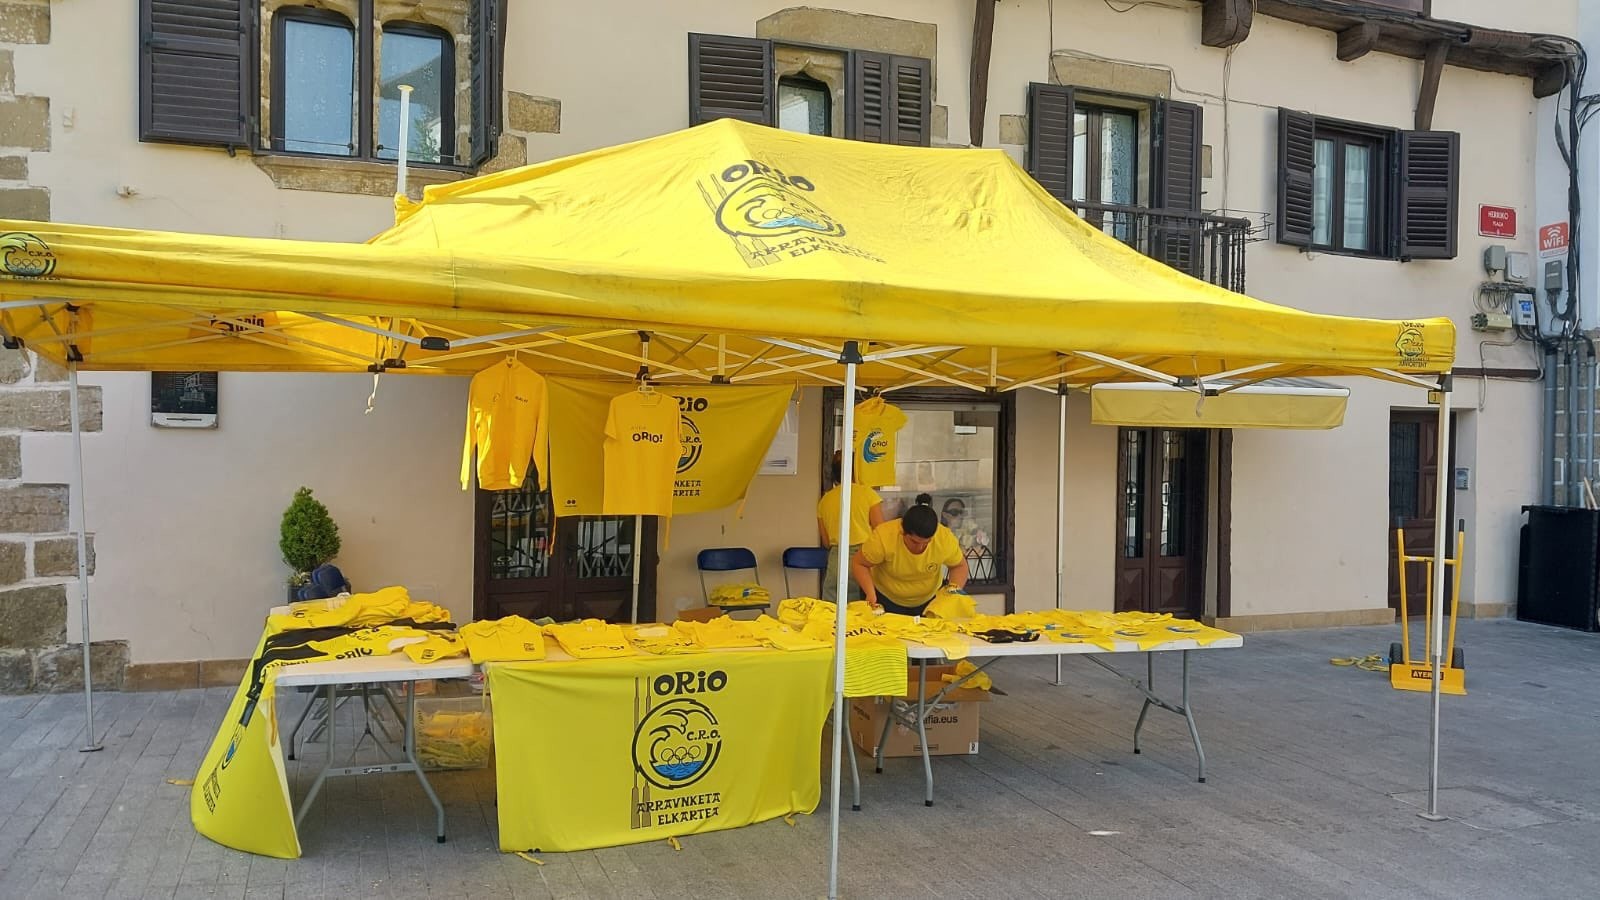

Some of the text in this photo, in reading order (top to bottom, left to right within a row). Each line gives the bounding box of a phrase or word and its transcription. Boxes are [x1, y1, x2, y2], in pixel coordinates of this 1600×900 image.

[1543, 235, 1565, 249] WiFi
[632, 431, 663, 443] ORIO!
[686, 729, 721, 741] C.R.O.
[657, 806, 720, 826] ELKARTEA
